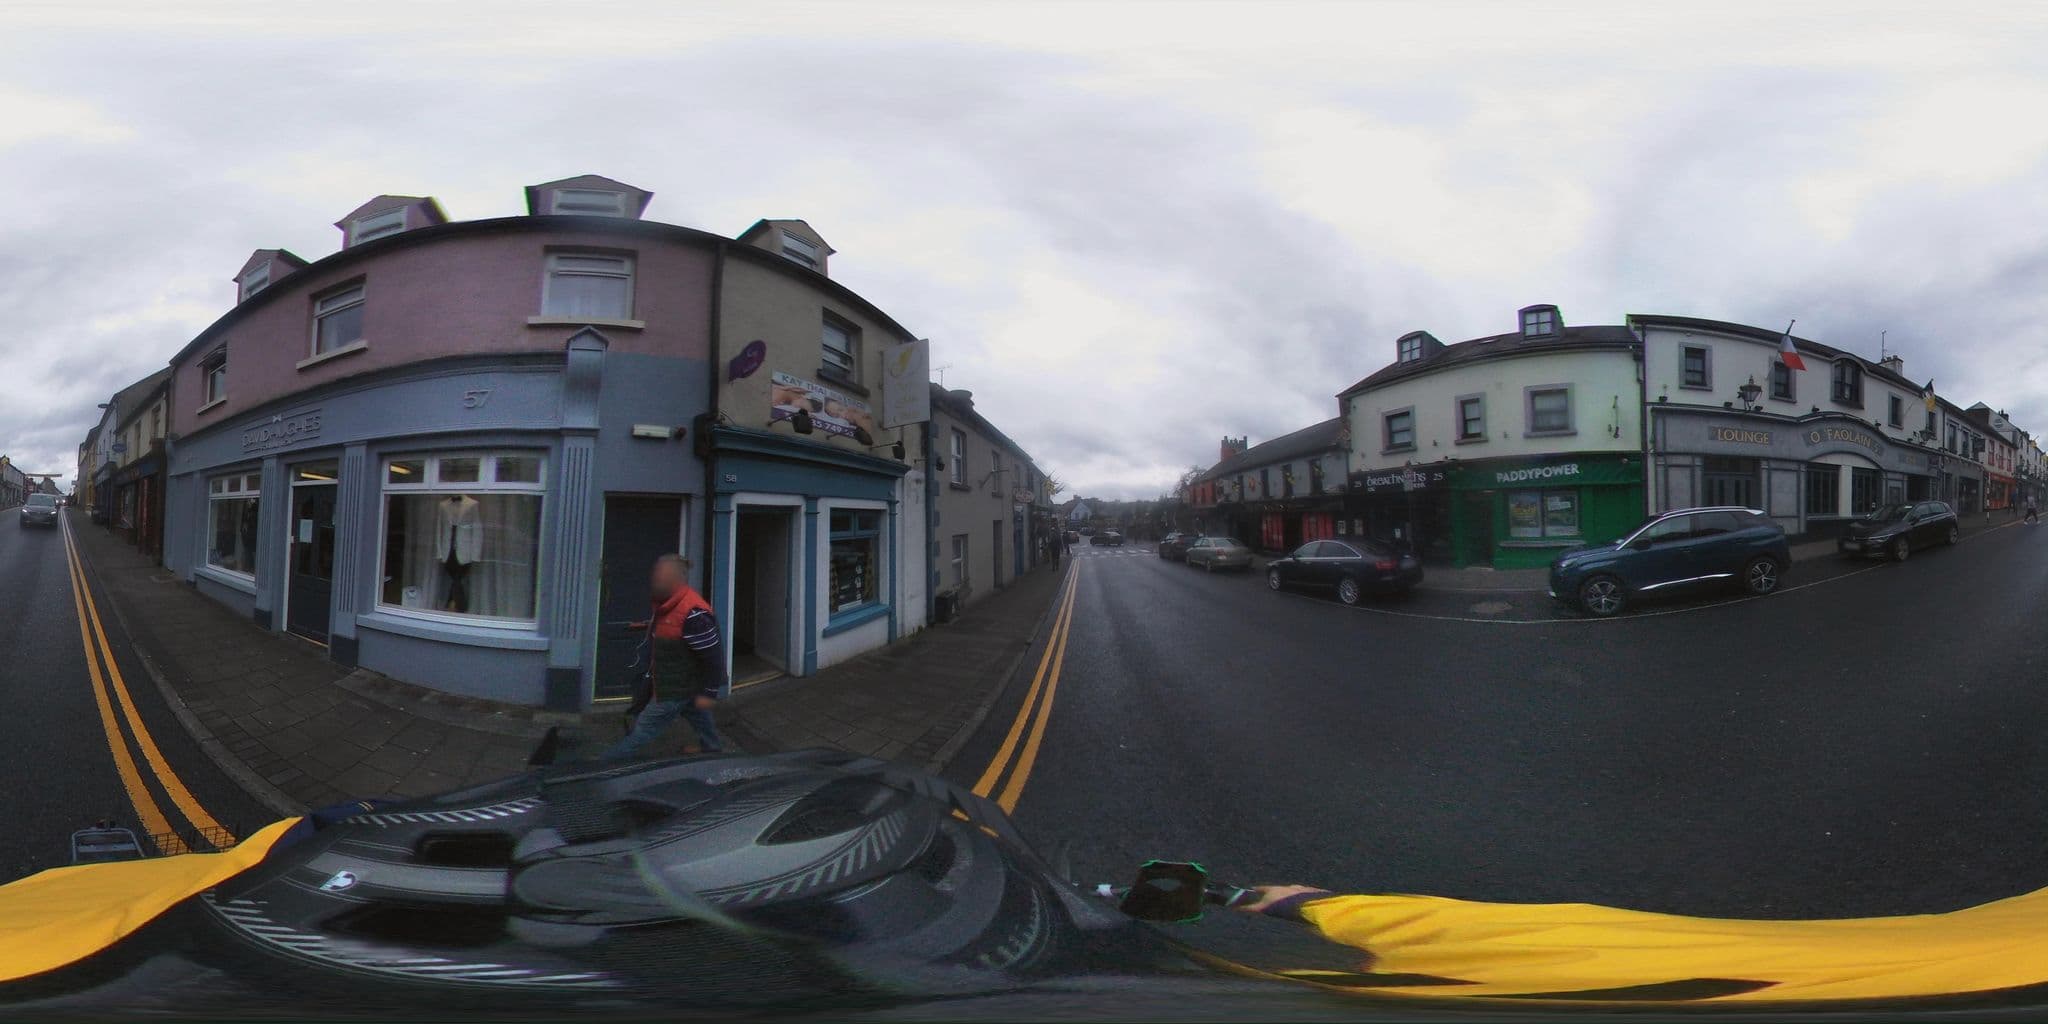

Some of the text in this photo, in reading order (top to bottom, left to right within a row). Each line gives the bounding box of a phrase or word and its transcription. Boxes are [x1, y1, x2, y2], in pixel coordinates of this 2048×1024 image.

[782, 375, 803, 388] KAY
[464, 388, 493, 408] 57
[1717, 429, 1769, 445] LOUNGE
[725, 474, 738, 483] 58
[1496, 463, 1580, 483] PADDYPOWER
